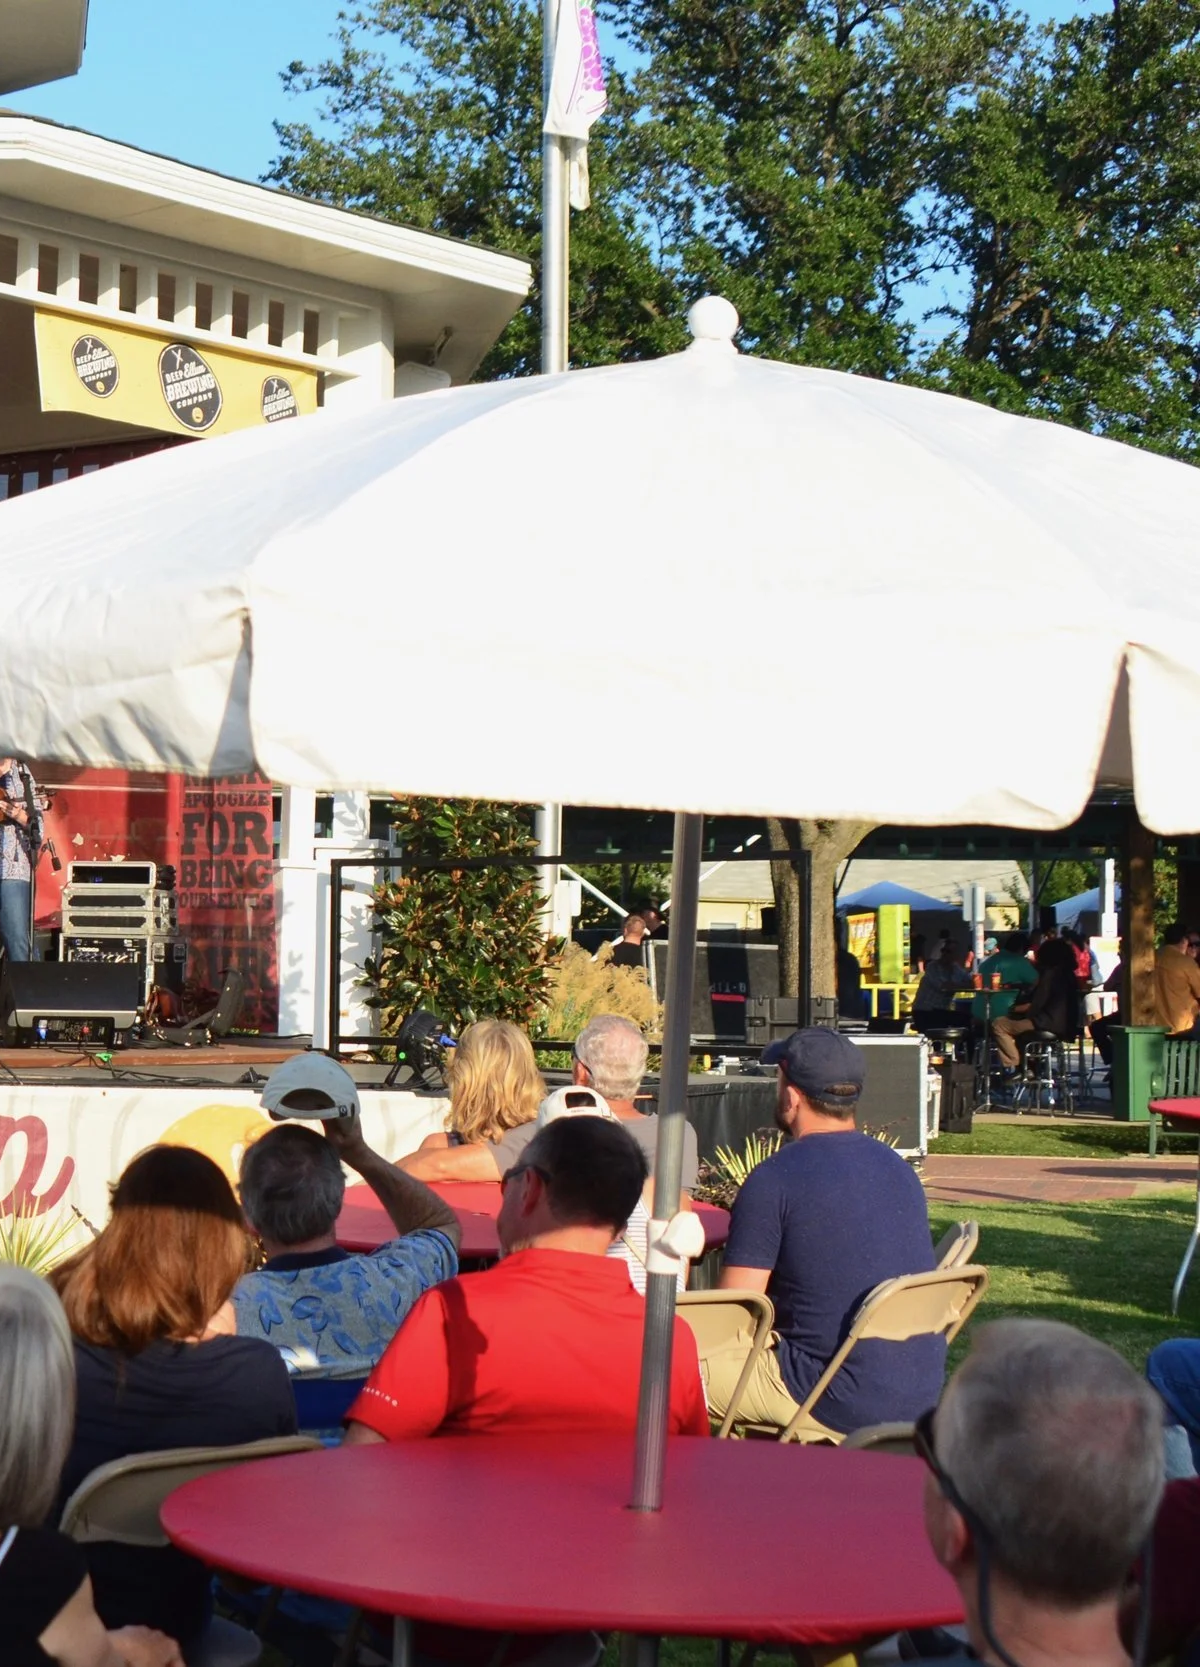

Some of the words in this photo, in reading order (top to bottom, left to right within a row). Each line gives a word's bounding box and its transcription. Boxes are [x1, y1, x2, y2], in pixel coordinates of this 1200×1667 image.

[76, 354, 91, 365] DEEP
[77, 355, 116, 377] BREWING
[165, 370, 184, 384] DEEP
[166, 373, 216, 402] BREWING
[176, 392, 213, 409] COMPANY
[181, 811, 269, 855] FOR
[179, 859, 273, 889] BEING
